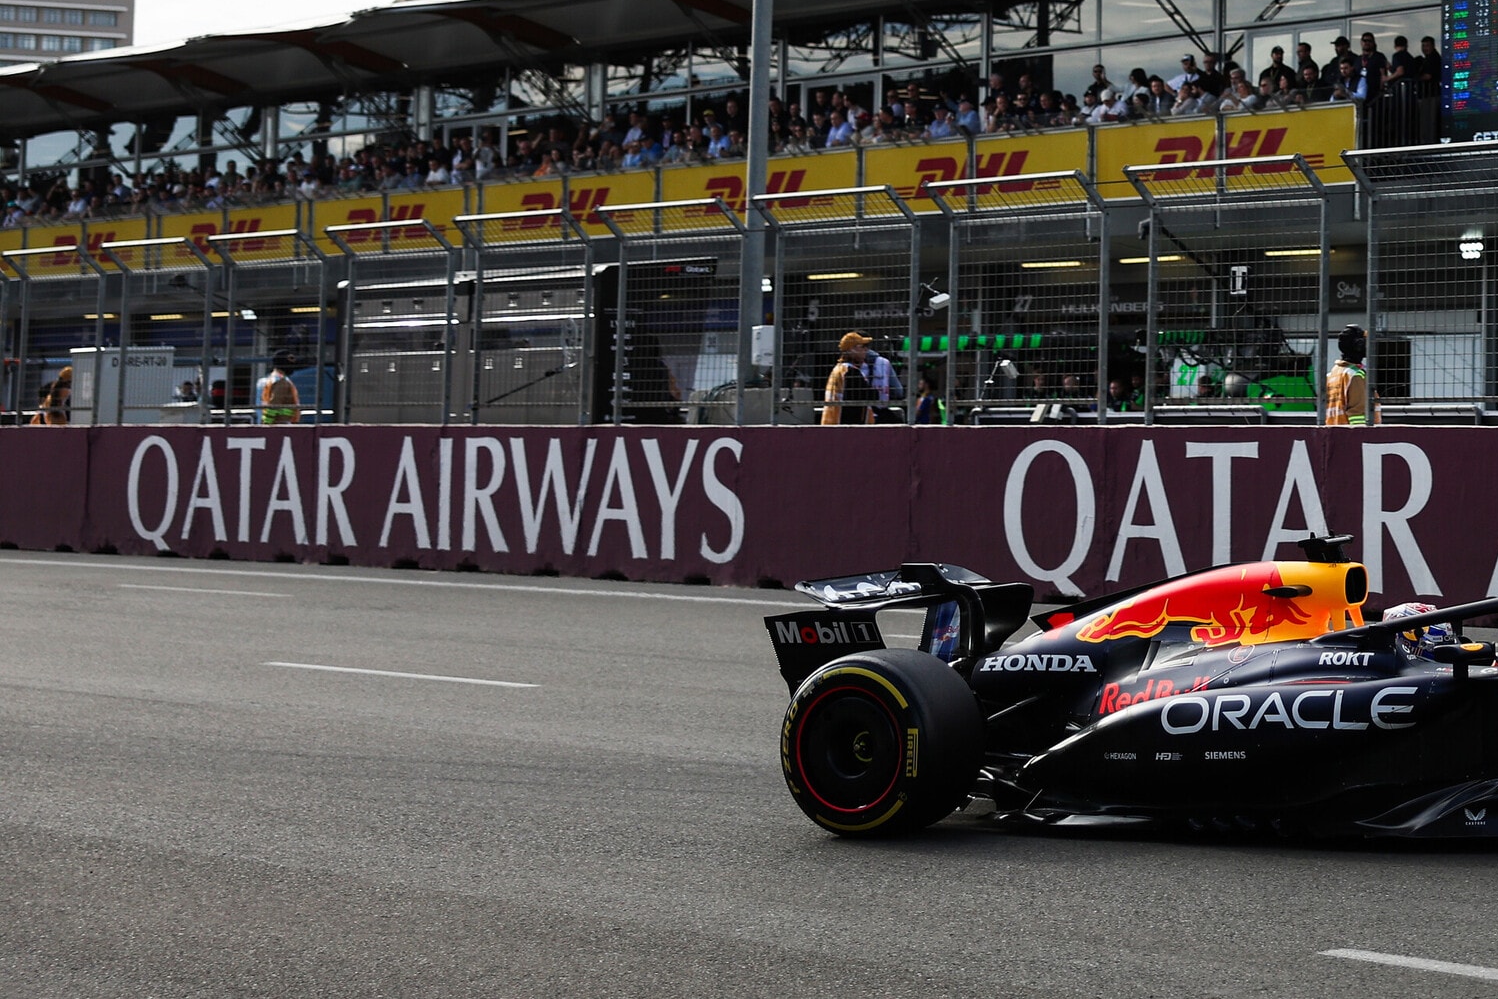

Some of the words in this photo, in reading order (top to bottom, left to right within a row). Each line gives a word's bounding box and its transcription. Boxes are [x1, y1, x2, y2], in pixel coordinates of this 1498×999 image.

[912, 151, 1034, 199] DHL
[1153, 127, 1295, 182] DHL
[520, 187, 615, 230] DHL
[704, 169, 814, 213] DHL
[189, 218, 264, 253] DHL
[346, 204, 432, 243] DHL
[52, 232, 119, 266] DHL
[127, 434, 358, 552] QATAR
[378, 435, 745, 565] AIRWAYS
[1003, 439, 1444, 598] QATAR
[775, 622, 850, 644] Mobil
[980, 654, 1098, 673] HONDA
[1318, 652, 1375, 666] ROKT
[1099, 680, 1154, 714] Red
[1160, 686, 1419, 735] ORACLE
[905, 728, 919, 778] PIRELLI
[1205, 751, 1246, 759] SIEMENS
